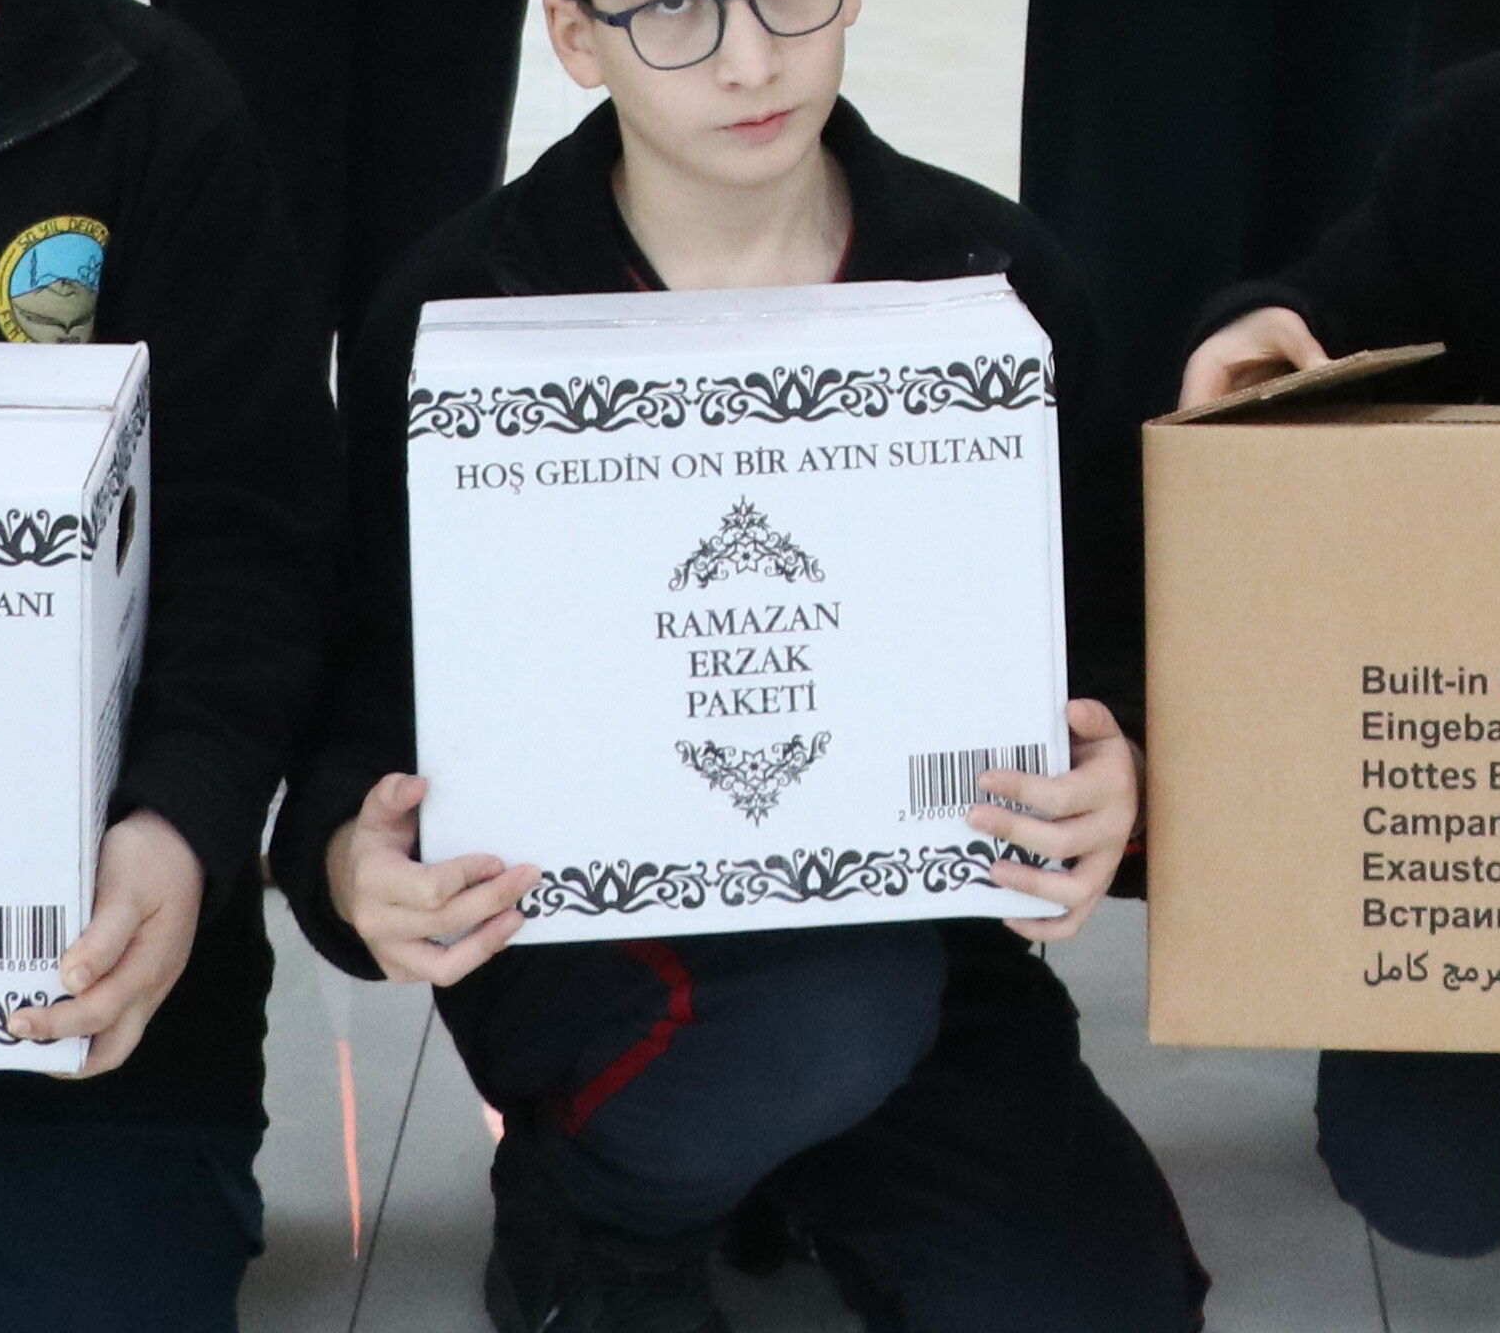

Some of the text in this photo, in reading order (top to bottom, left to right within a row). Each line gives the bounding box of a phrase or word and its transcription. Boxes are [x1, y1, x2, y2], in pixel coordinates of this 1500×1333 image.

[456, 434, 1022, 493] HOŞ GELDİN ON BİR AYIN SULTANI
[656, 602, 839, 640] RAMAZAN
[690, 645, 811, 678] ERZAK
[1362, 665, 1488, 696] Built-in
[688, 680, 815, 718] PAKETİ
[1362, 759, 1477, 790] Hottes
[918, 806, 965, 820] 20000
[1363, 951, 1429, 988] كامل
